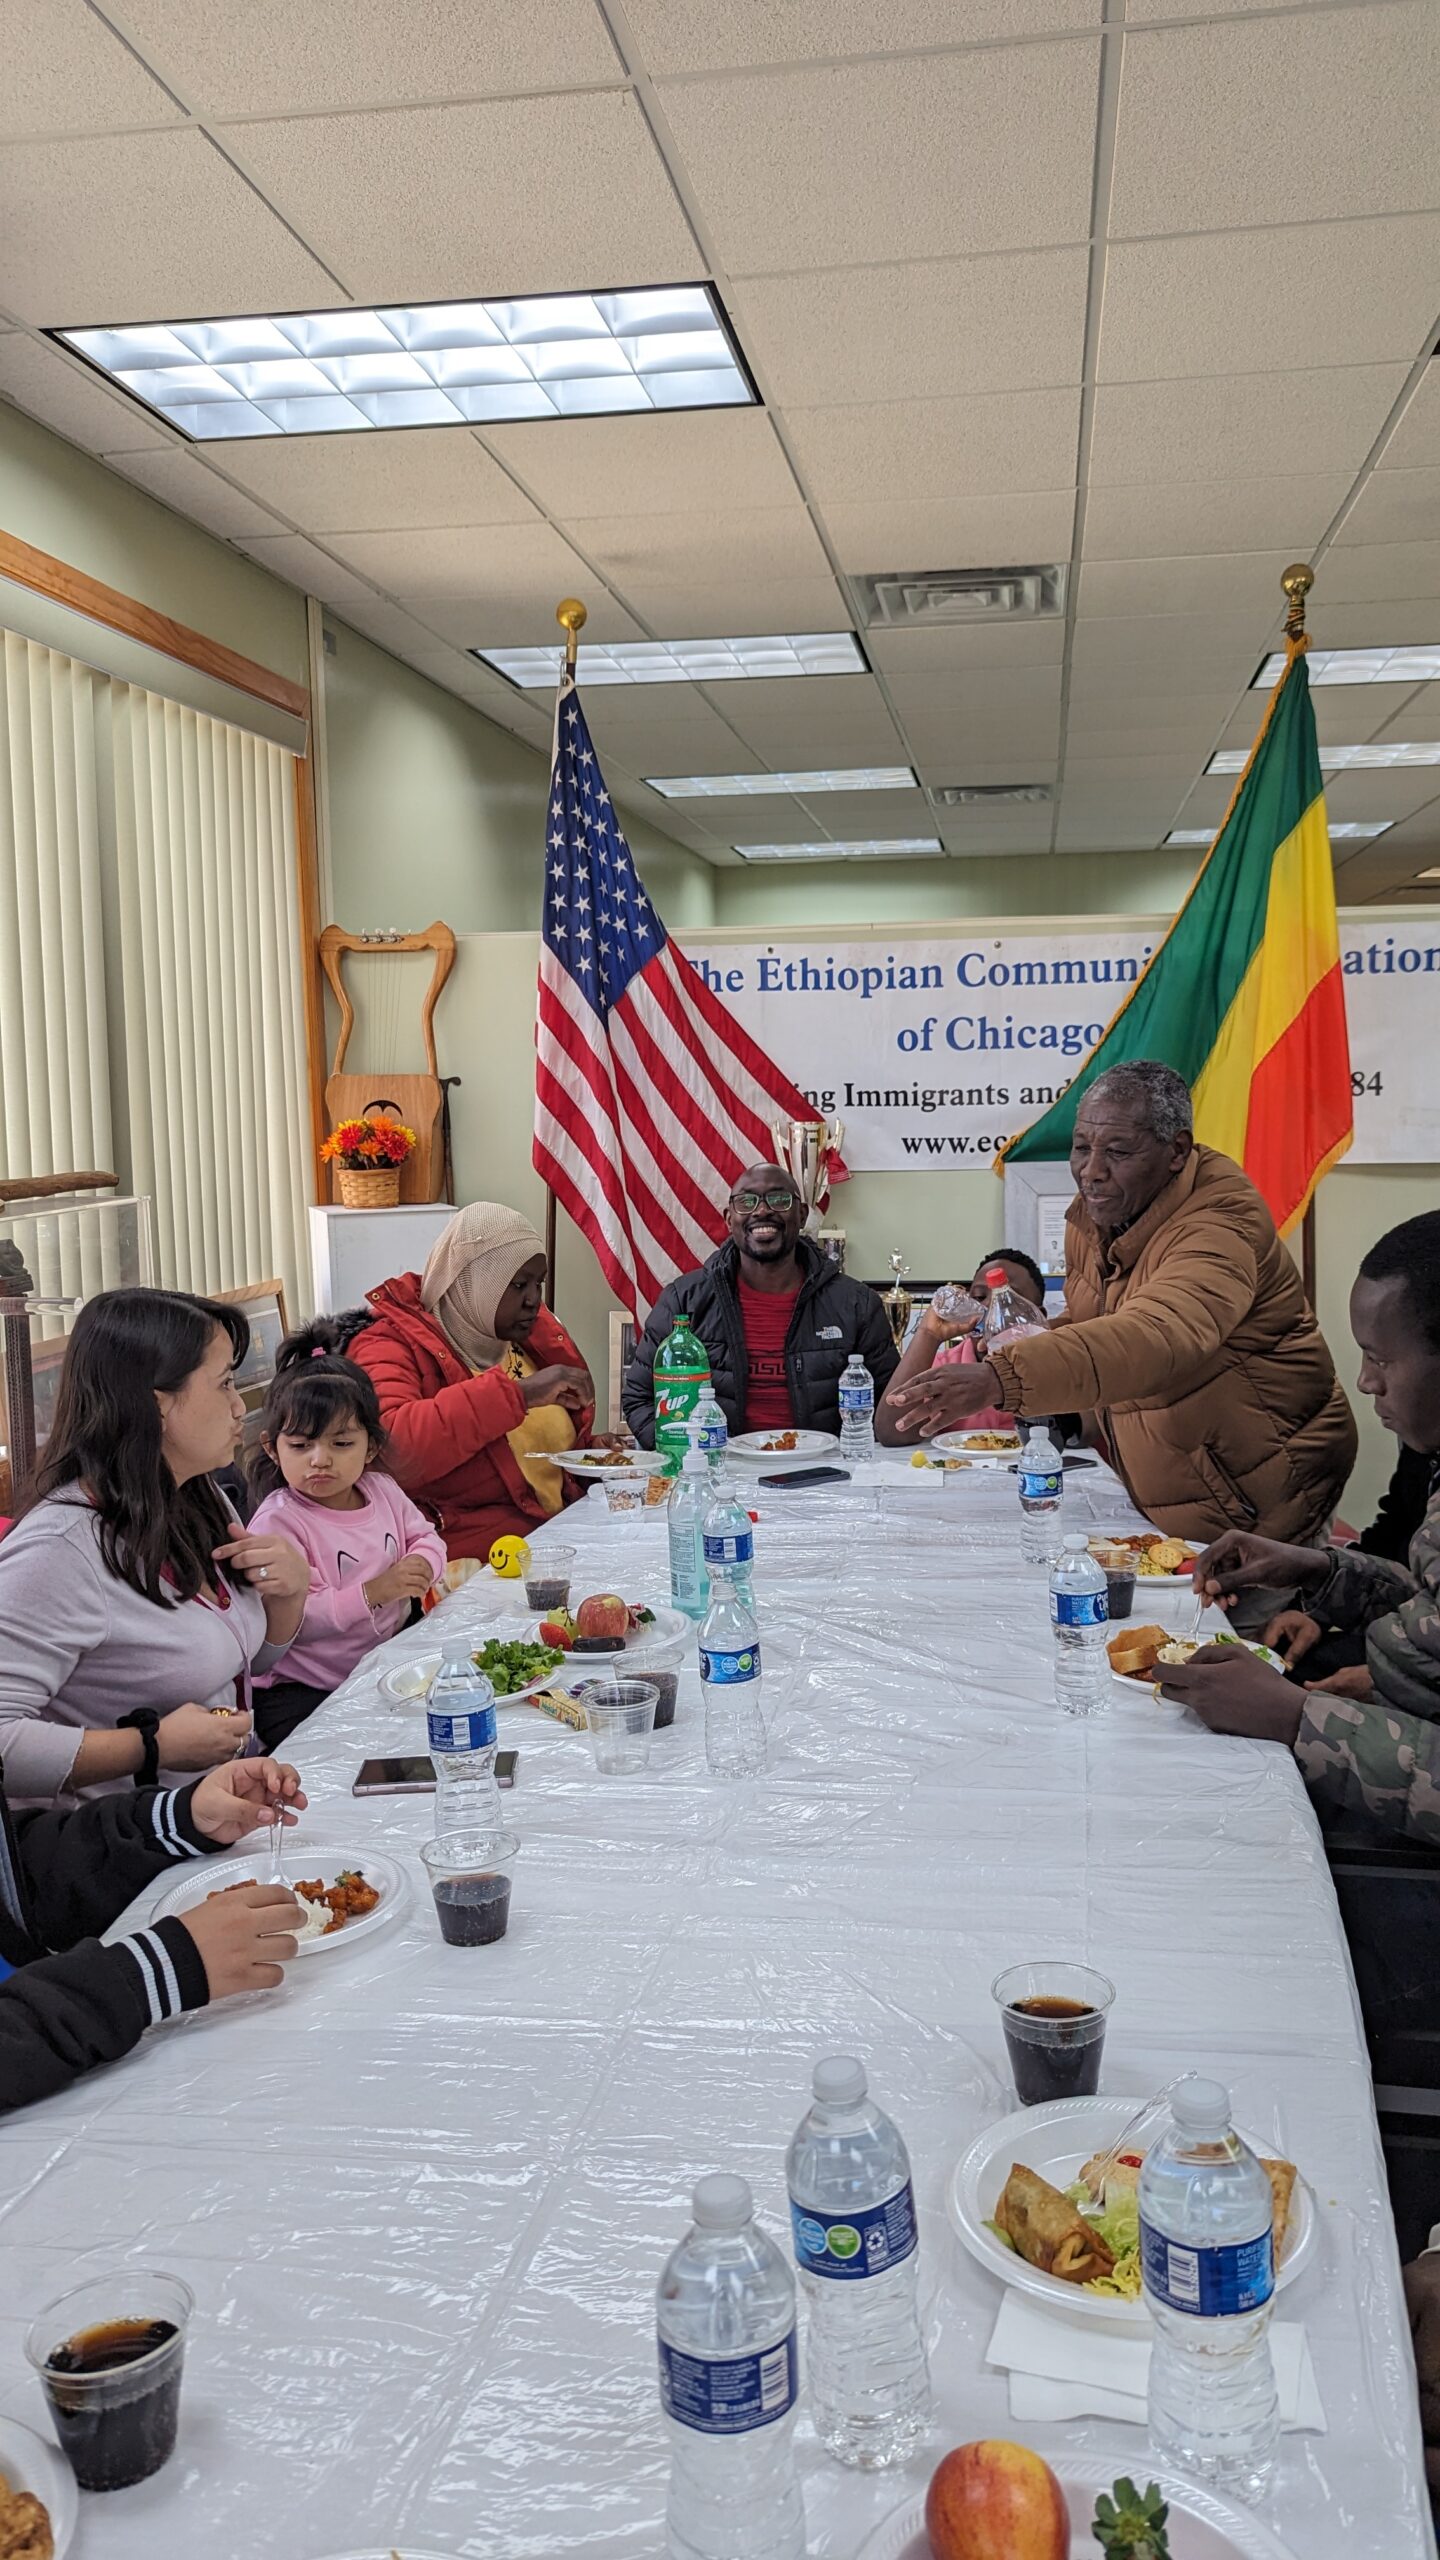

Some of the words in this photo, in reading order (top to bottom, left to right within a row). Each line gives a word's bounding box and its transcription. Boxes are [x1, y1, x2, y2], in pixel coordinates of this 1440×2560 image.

[756, 956, 944, 999] Ethiopian
[897, 1017, 938, 1052] of
[945, 1015, 1105, 1056] Chicago
[794, 1082, 836, 1113] ng
[843, 1081, 1010, 1113] Immigrants
[901, 1134, 1017, 1155] www.ec
